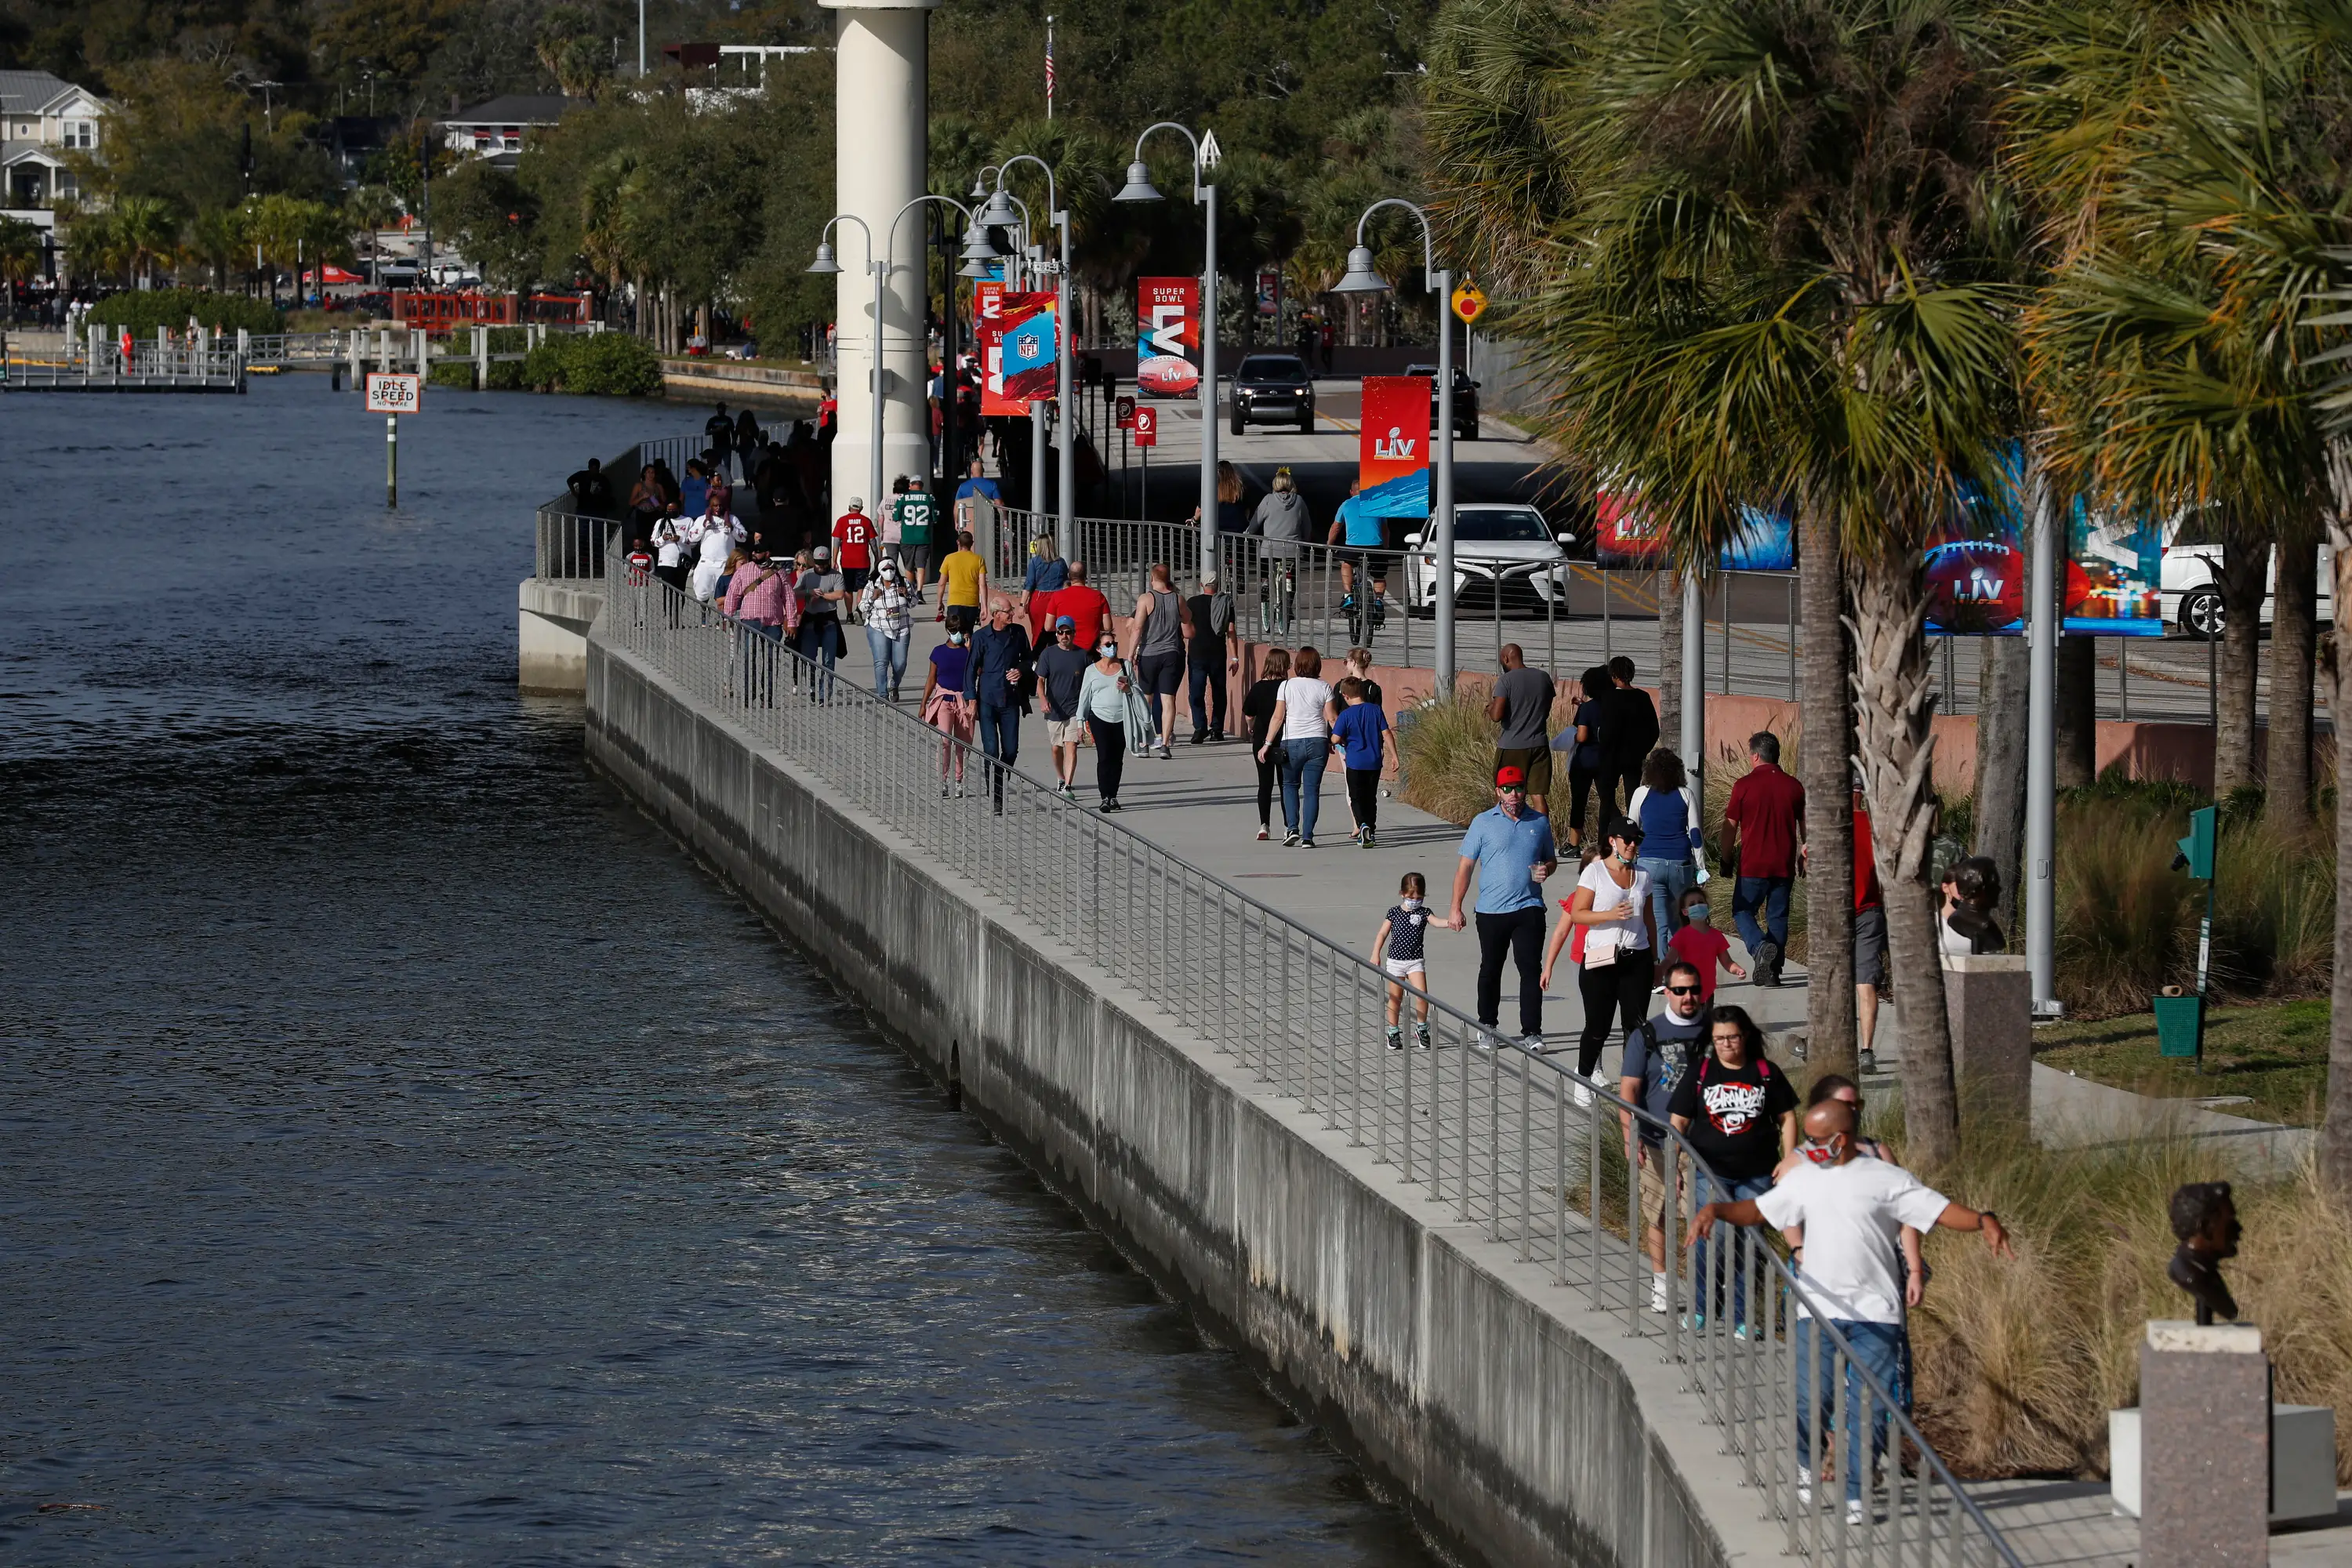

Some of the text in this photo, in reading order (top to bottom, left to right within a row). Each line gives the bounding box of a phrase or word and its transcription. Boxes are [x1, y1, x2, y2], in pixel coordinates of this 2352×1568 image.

[1019, 345, 1036, 356] NFL
[379, 380, 407, 390] IDLE
[372, 390, 414, 401] SPEED
[904, 505, 930, 526] 92
[847, 526, 864, 543] 12
